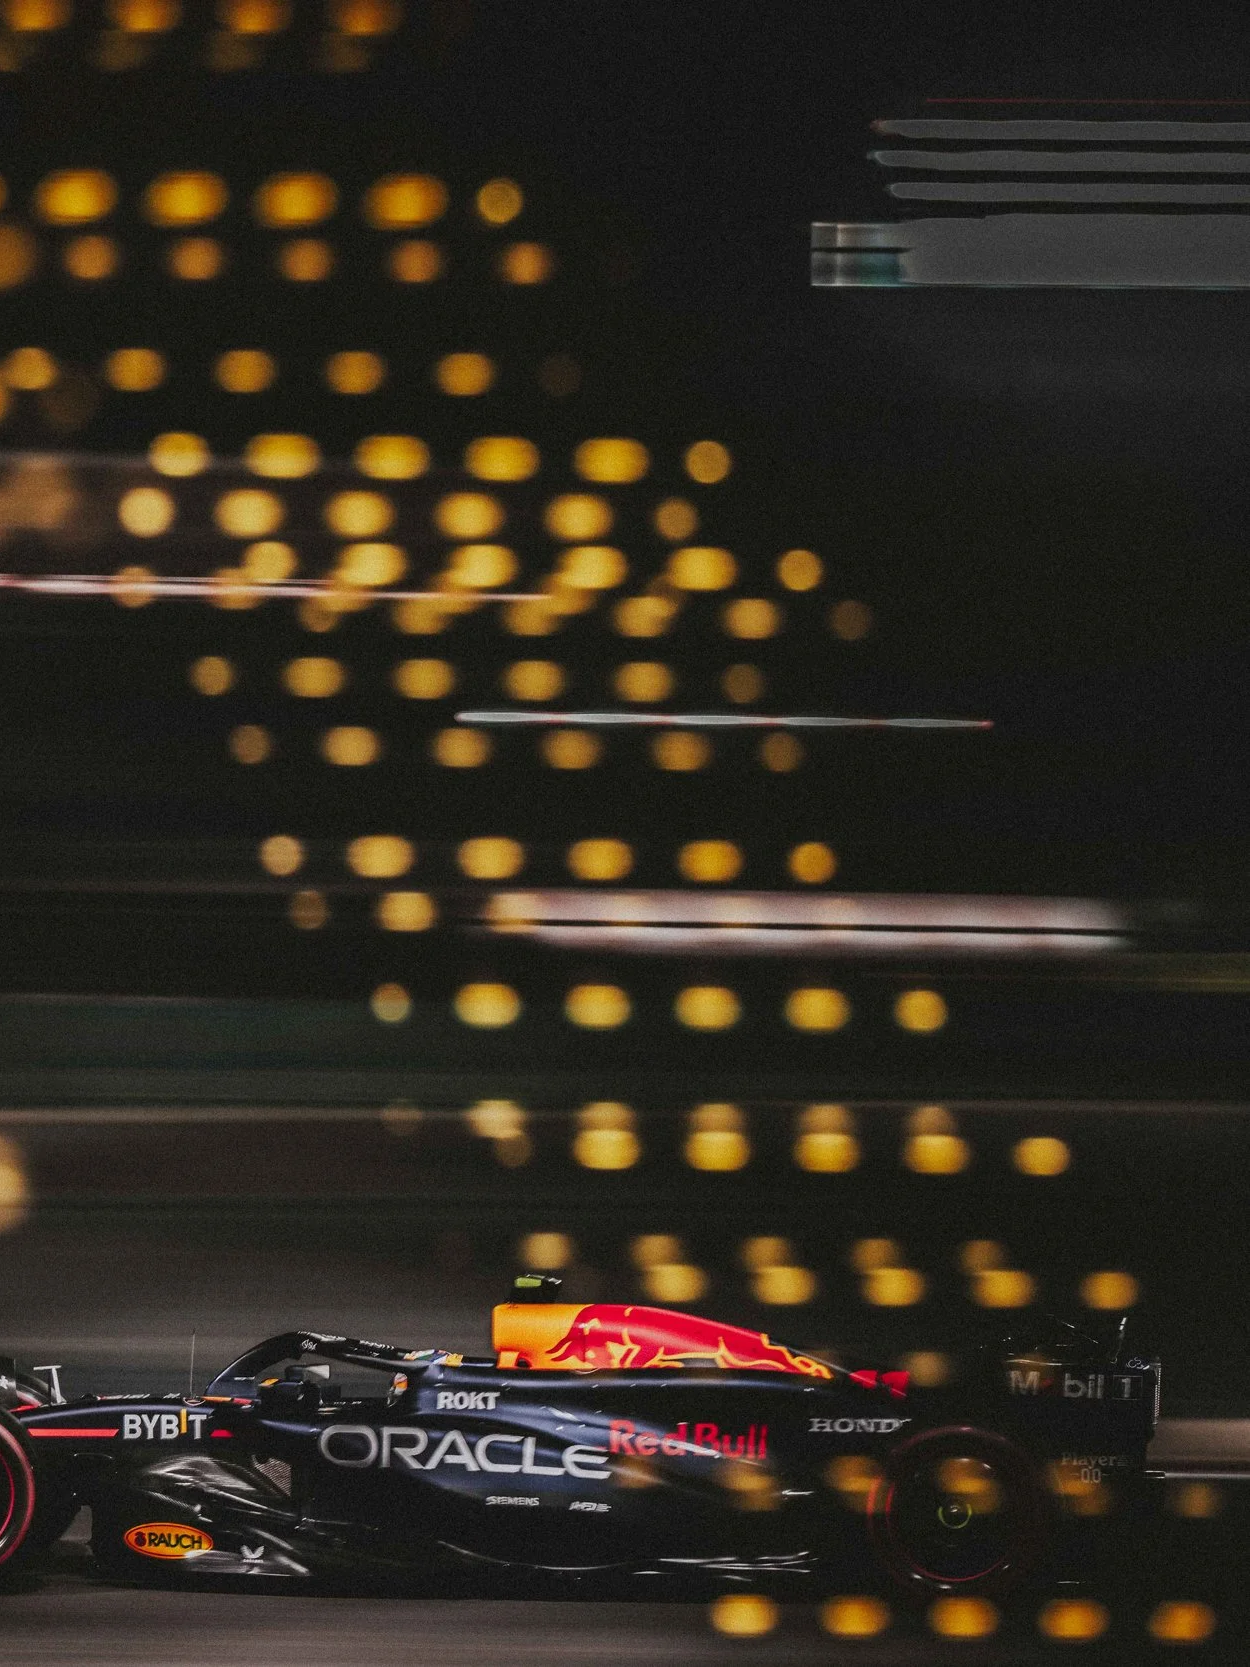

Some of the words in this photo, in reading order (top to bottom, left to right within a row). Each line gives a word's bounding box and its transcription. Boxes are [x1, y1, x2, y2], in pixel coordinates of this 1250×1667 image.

[1120, 1377, 1132, 1398] 1
[436, 1390, 500, 1410] ROKT
[123, 1408, 207, 1440] BYBIT
[609, 1419, 688, 1456] Red
[694, 1423, 768, 1460] Bull
[320, 1424, 612, 1480] ORACLE
[486, 1496, 540, 1506] SIEMENS
[147, 1532, 203, 1549] RAUCH
